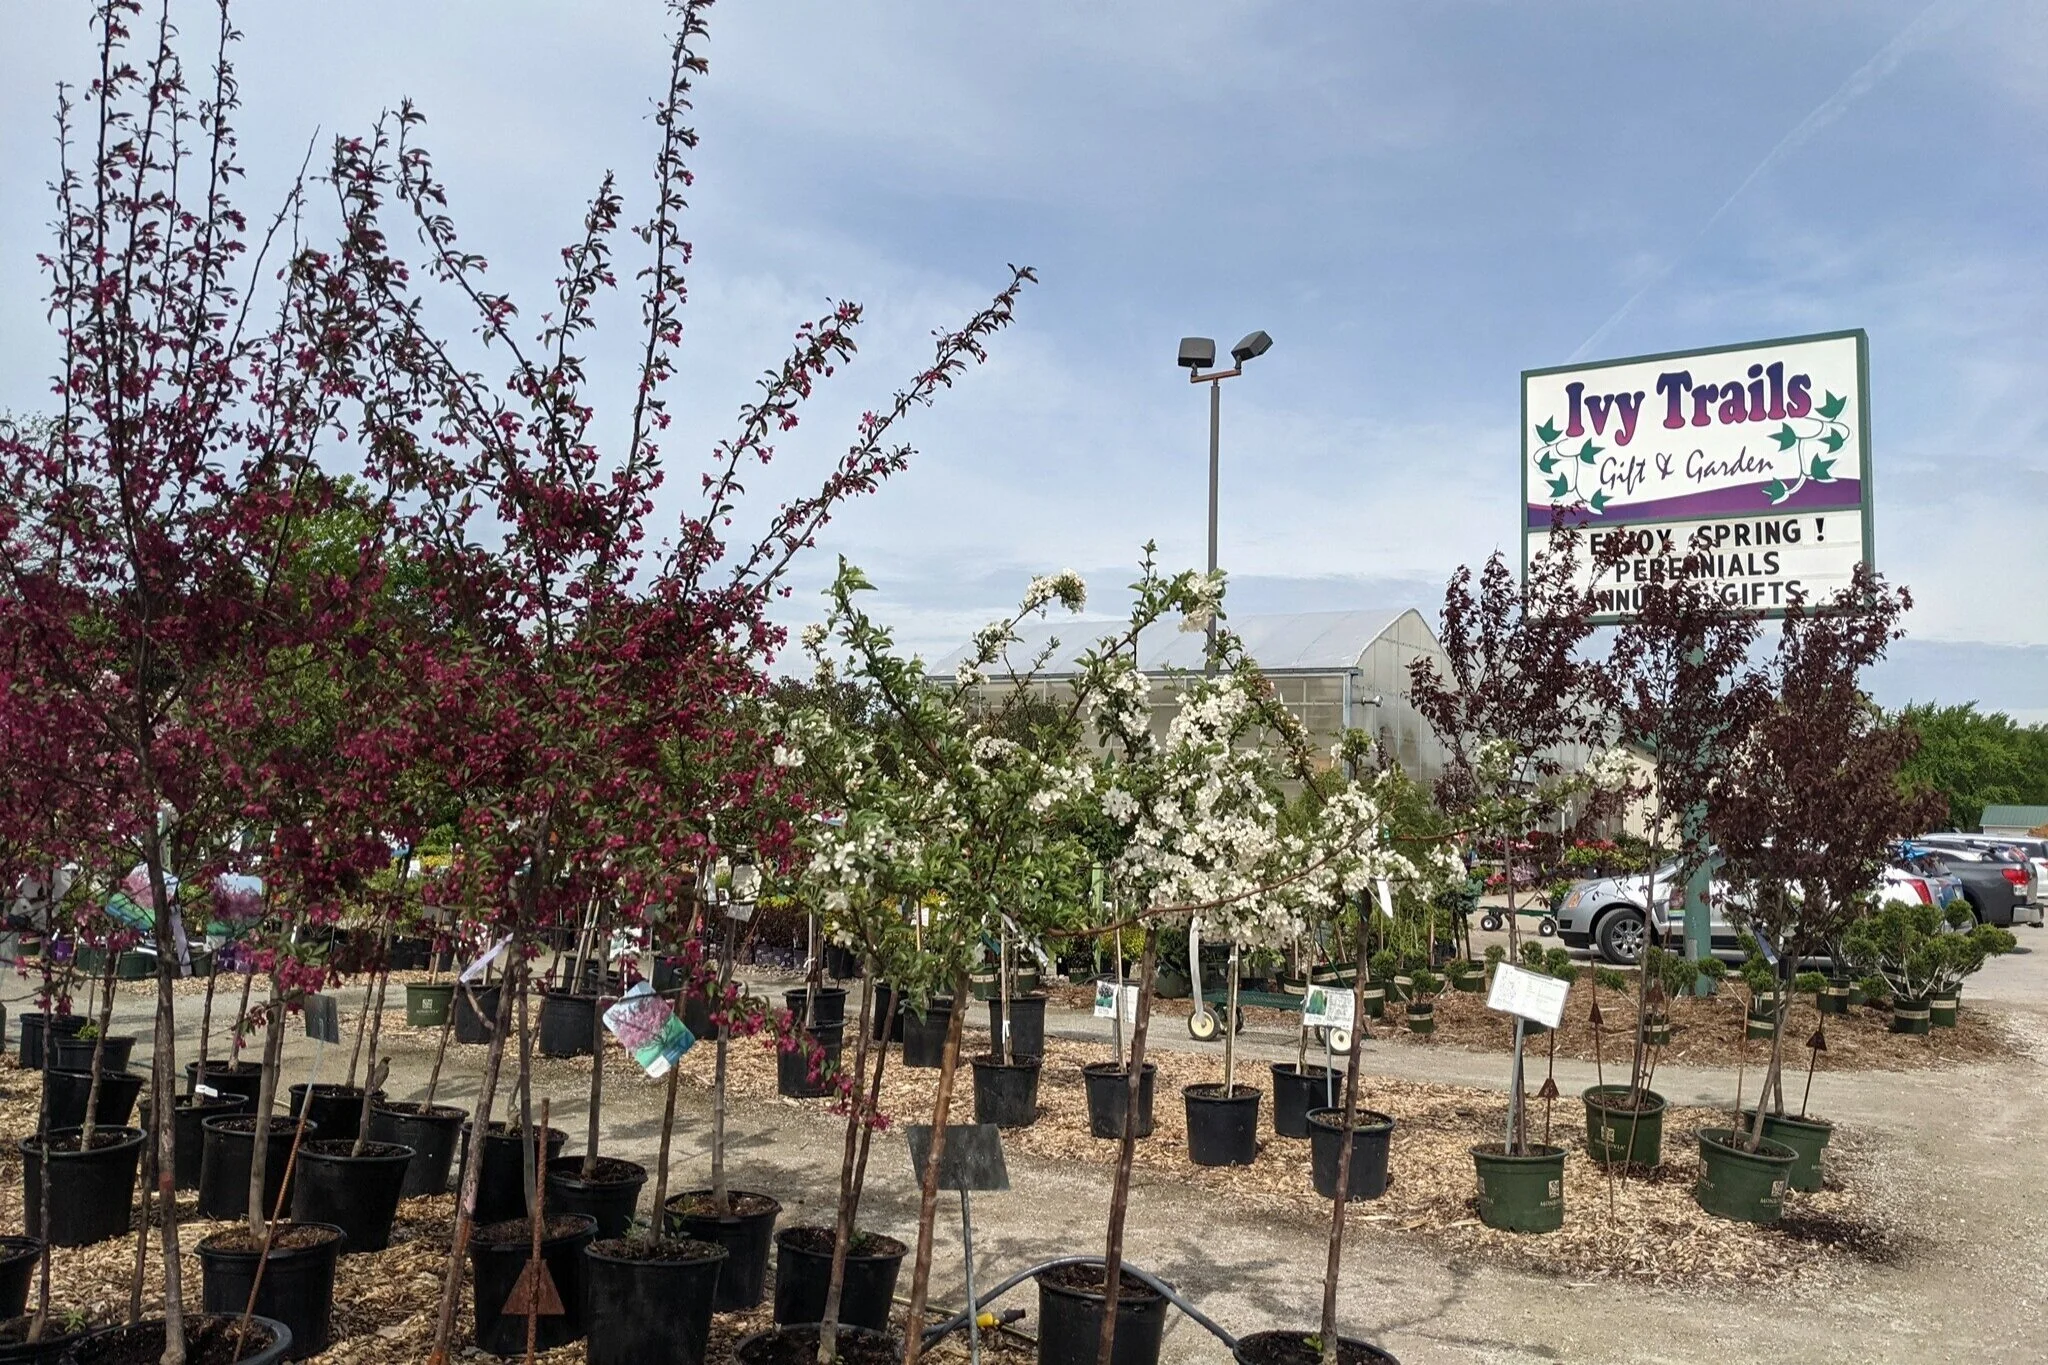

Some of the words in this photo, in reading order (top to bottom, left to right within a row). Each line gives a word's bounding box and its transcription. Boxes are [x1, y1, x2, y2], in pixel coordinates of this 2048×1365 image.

[1565, 381, 1645, 446] Ivy
[1656, 361, 1812, 429] Trails
[1600, 456, 1646, 495] Gift
[1655, 452, 1675, 480] &
[1686, 446, 1773, 483] Garden
[1590, 528, 1672, 555] EOY
[1697, 519, 1801, 548] SPRING
[1720, 580, 1802, 606] GIFTS
